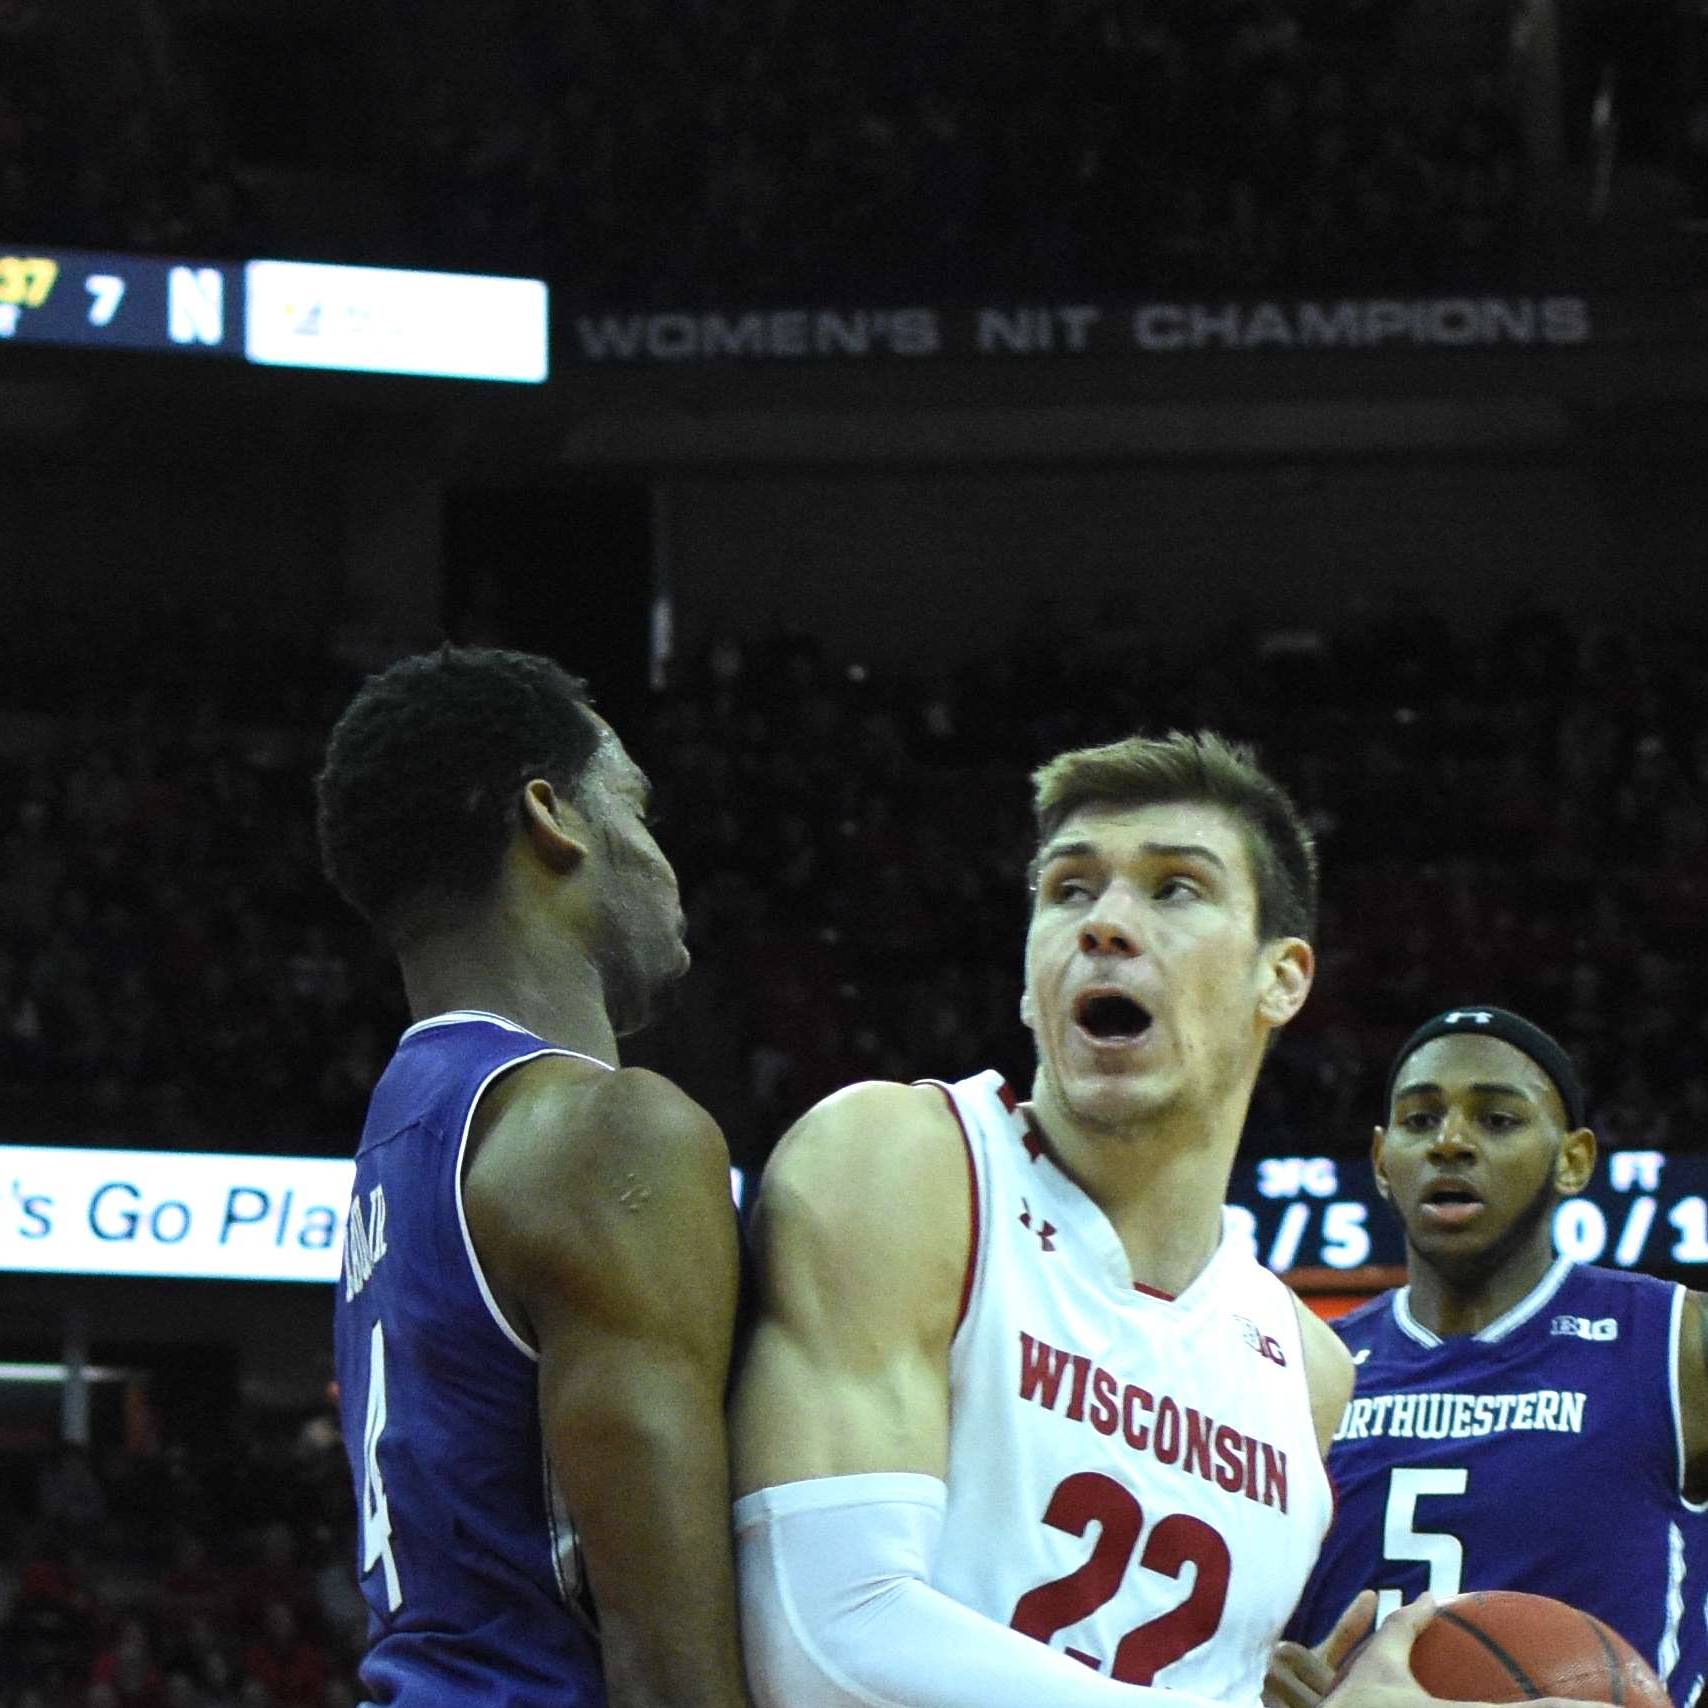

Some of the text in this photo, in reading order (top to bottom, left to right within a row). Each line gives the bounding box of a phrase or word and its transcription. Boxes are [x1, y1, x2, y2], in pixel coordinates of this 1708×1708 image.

[85, 274, 125, 326] 7
[167, 266, 223, 346] N
[575, 296, 1591, 361] WOMEN'S NIT CHAMPIONS
[87, 1180, 193, 1245] Go
[218, 1184, 338, 1251] Pla
[1020, 1332, 1287, 1514] WISCONSIN
[1010, 1472, 1232, 1688] 22
[1374, 1468, 1468, 1632] 5
